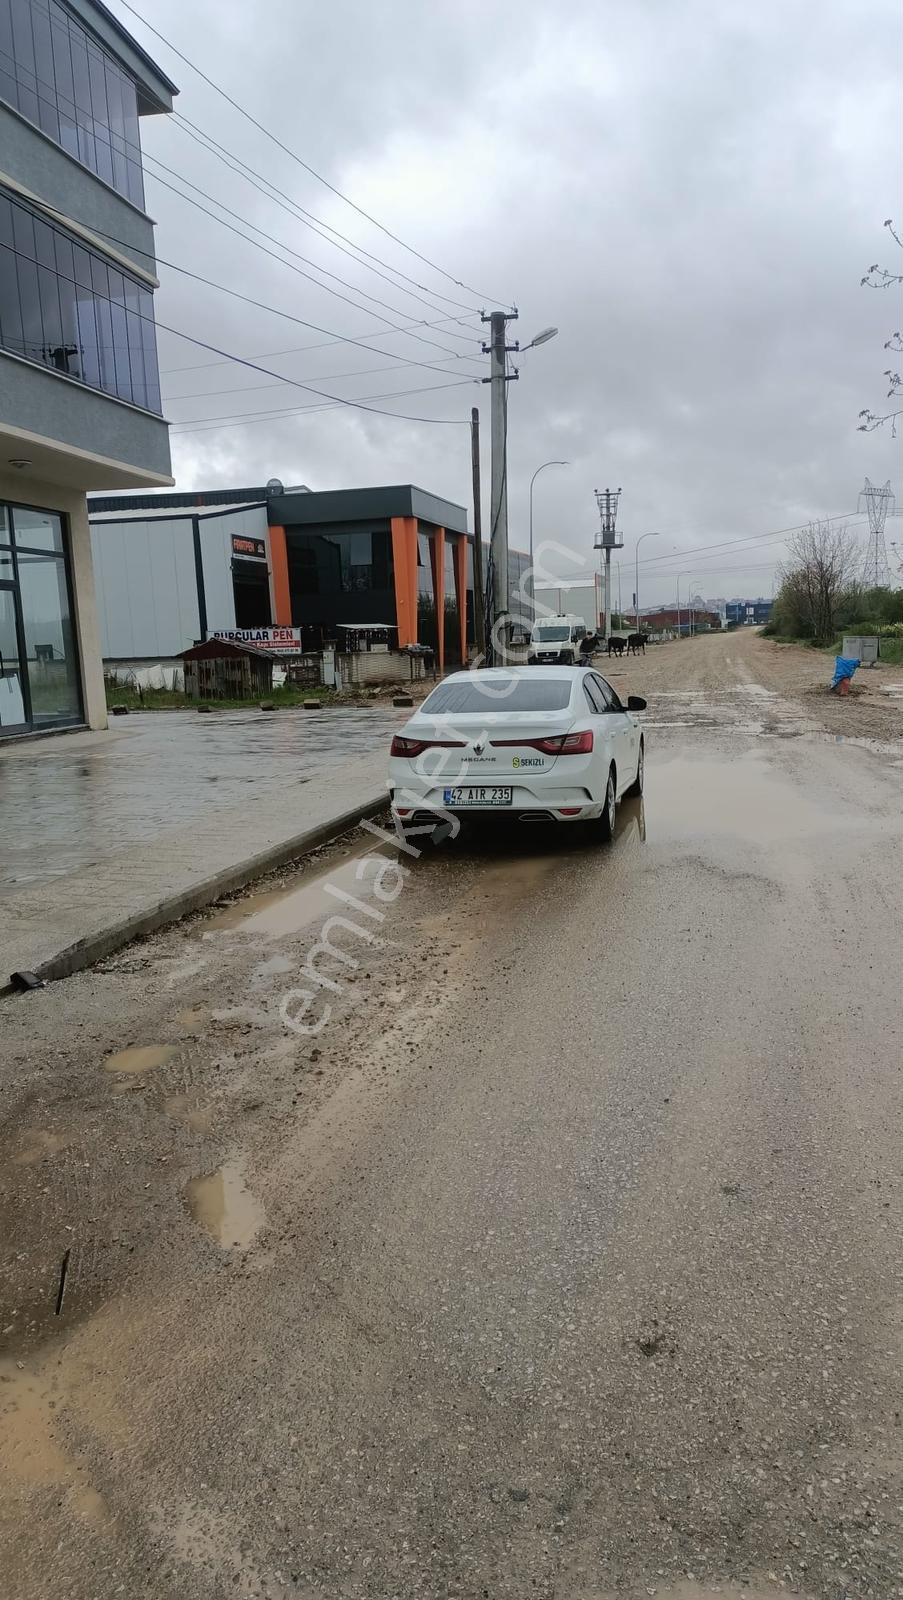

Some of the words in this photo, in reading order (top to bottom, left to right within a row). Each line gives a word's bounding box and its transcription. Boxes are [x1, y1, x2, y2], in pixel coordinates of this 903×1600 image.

[272, 630, 293, 640] PEN
[451, 789, 463, 799] 42
[468, 789, 486, 799] AIR
[491, 788, 510, 799] 235
